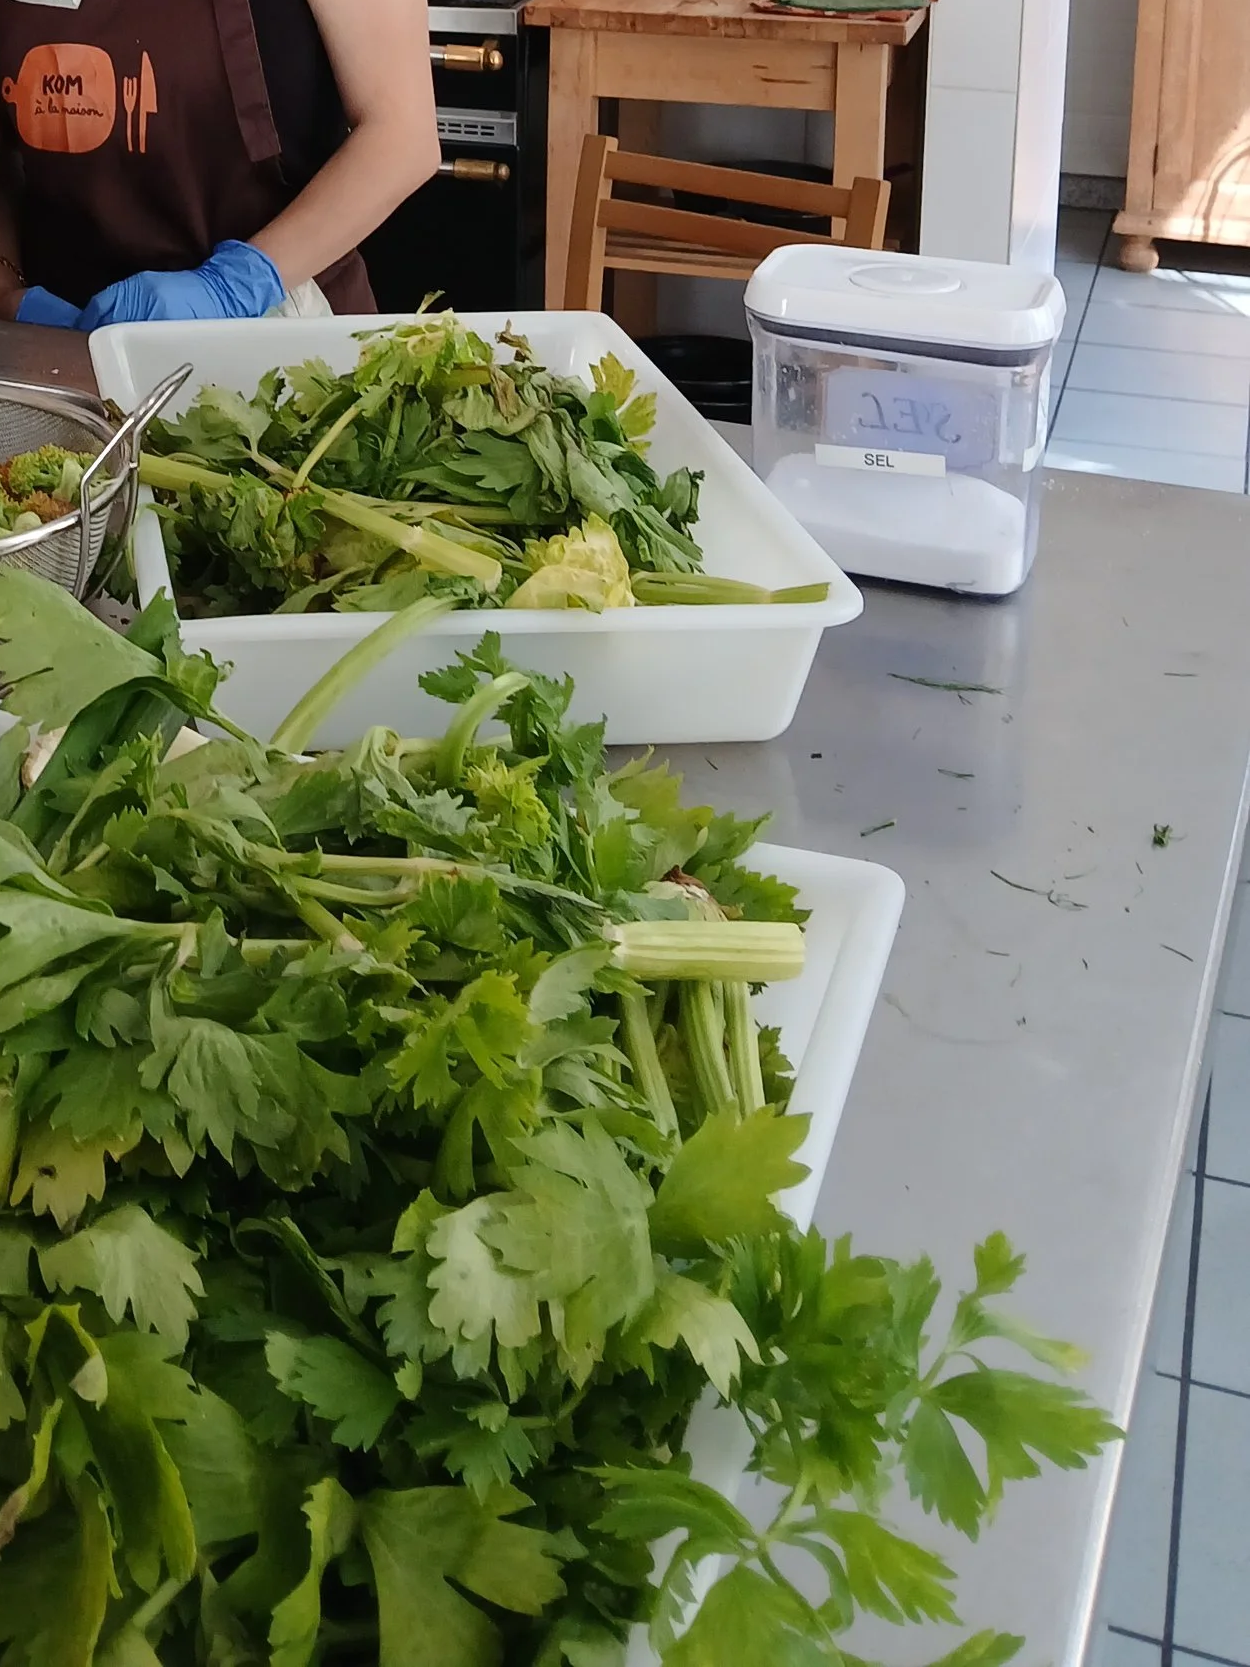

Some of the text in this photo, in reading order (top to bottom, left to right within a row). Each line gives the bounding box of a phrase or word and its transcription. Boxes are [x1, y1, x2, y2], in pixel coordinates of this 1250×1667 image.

[42, 74, 83, 96] KOM
[34, 99, 46, 116] à
[48, 96, 60, 114] la
[864, 453, 895, 468] SEL
